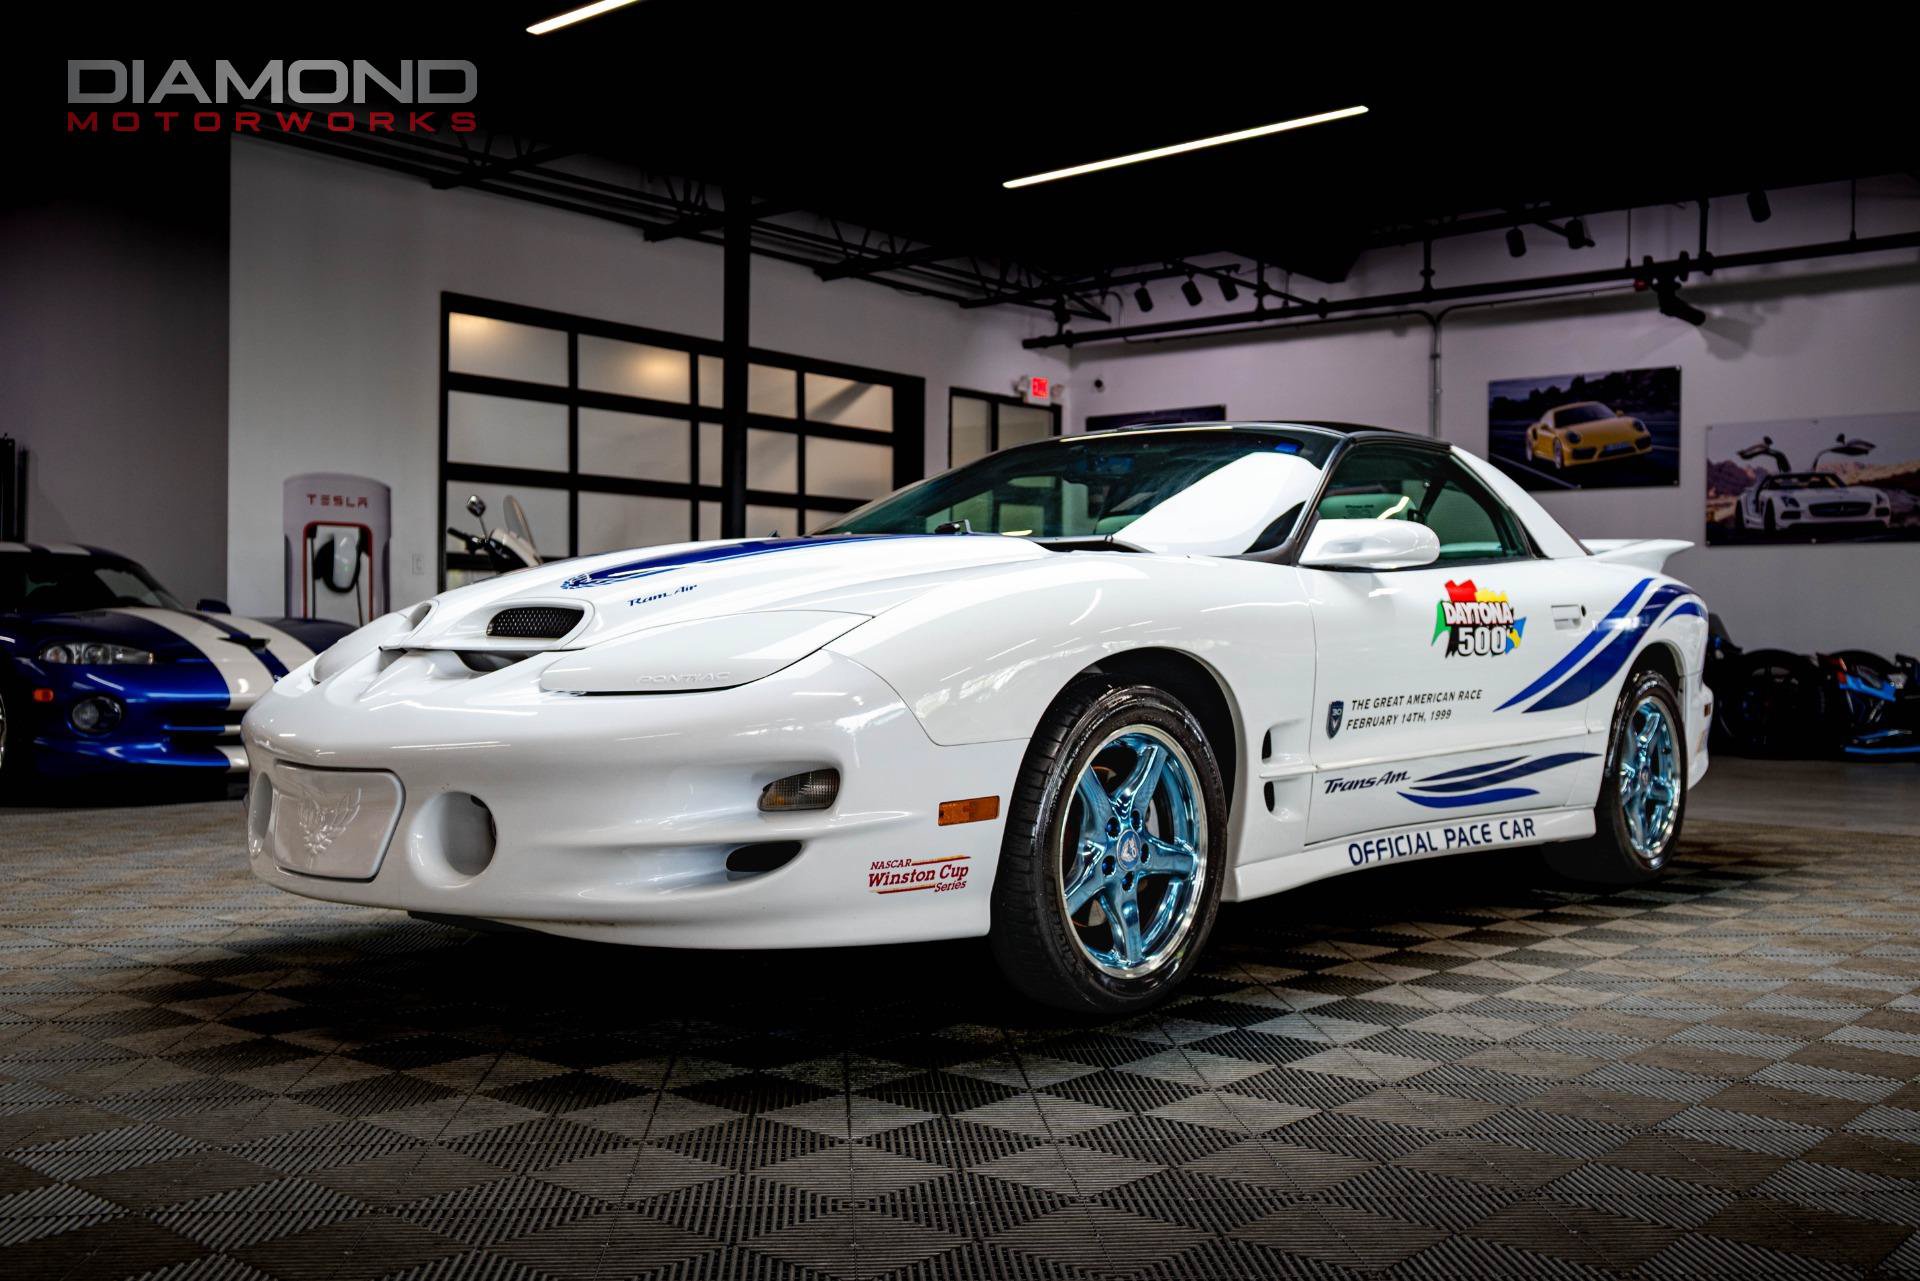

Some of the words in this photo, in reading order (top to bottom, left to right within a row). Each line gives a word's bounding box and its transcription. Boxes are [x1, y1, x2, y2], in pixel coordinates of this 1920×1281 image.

[306, 493, 369, 508] TESLA
[627, 592, 668, 607] Ram
[674, 584, 698, 595] Air
[1440, 600, 1515, 626] DAYTONA
[1457, 626, 1507, 657] 500
[636, 672, 731, 685] PONTIAC
[1352, 699, 1371, 711] THE
[1373, 695, 1405, 709] GREAT
[1406, 690, 1456, 705] AMERICAN
[1458, 689, 1483, 702] RACE
[1346, 714, 1399, 731] FEBRUARY
[1401, 712, 1426, 724] 14TH,
[1430, 709, 1453, 721] 1999
[1348, 831, 1438, 866] OFFICIAL
[1443, 823, 1493, 850] PACE
[1500, 817, 1536, 841] CAR
[870, 858, 912, 870] NASCAR
[868, 868, 936, 888] Winston
[940, 864, 969, 880] Cup
[934, 880, 967, 893] Series
